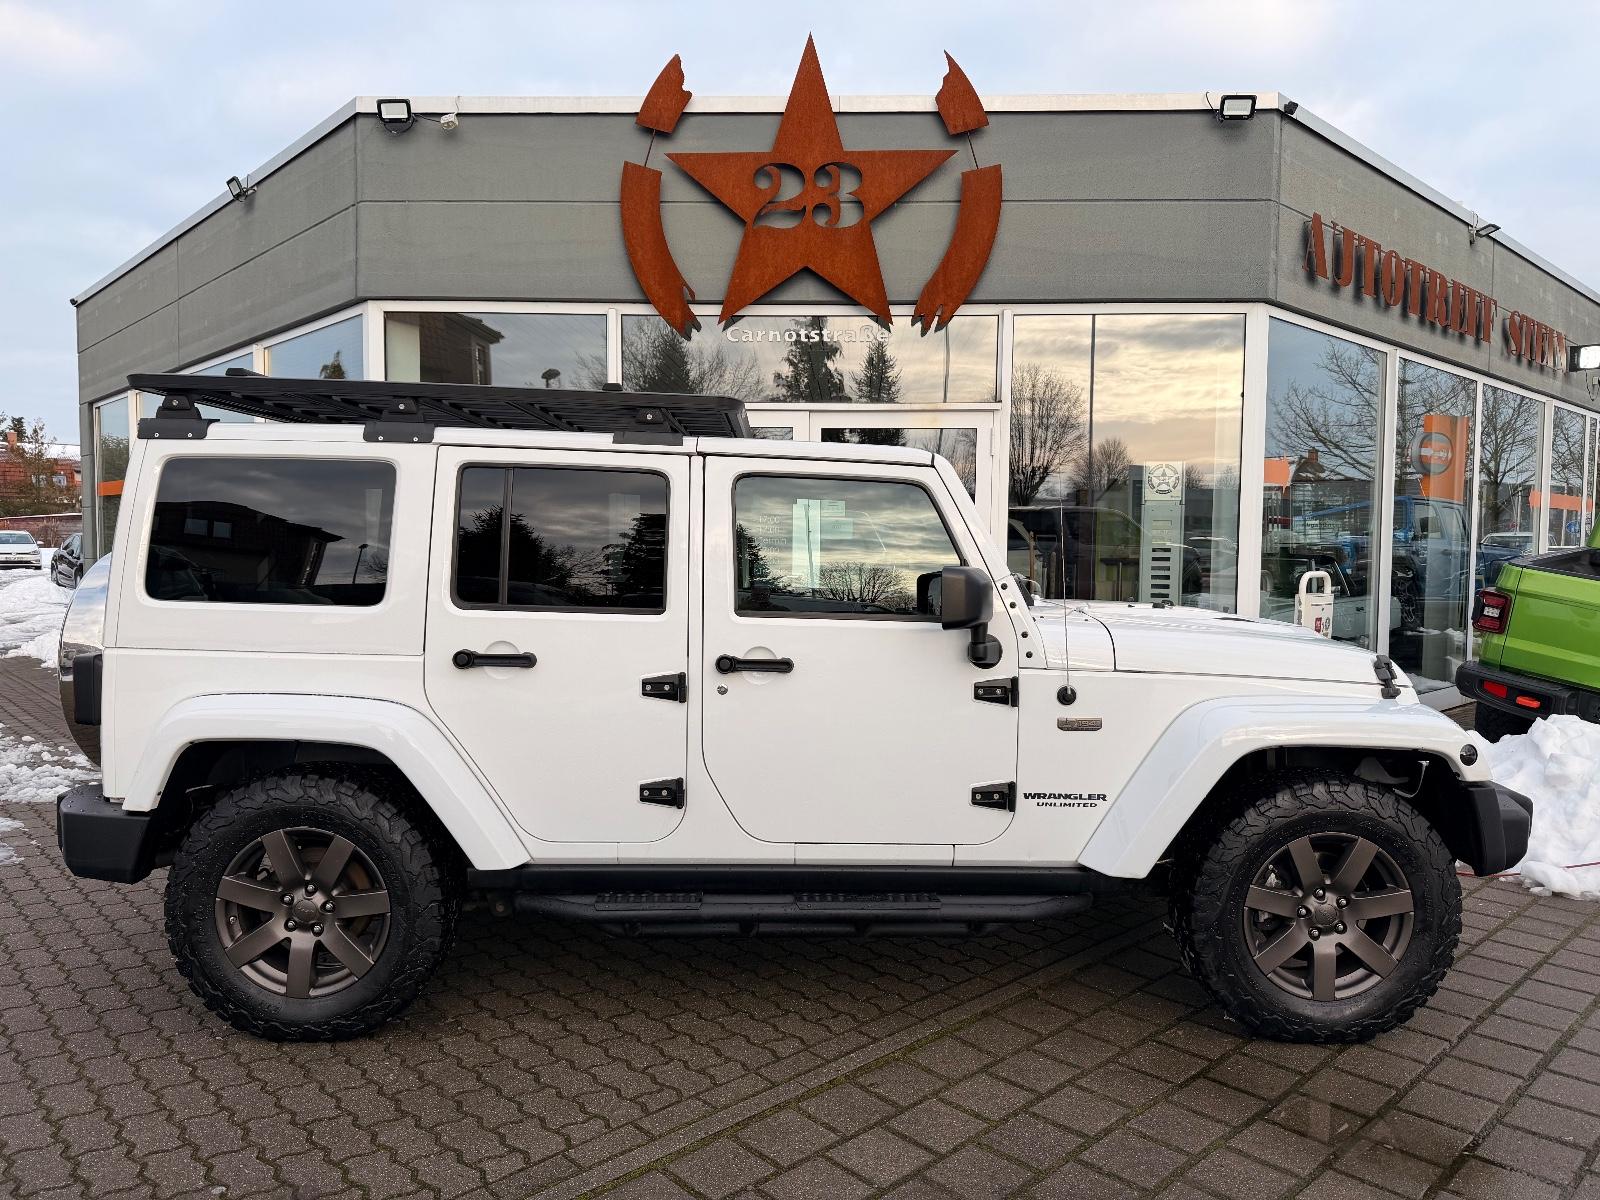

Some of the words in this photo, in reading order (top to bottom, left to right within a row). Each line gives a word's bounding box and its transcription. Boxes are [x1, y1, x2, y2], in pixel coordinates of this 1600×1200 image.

[752, 161, 865, 230] 23
[726, 324, 890, 343] Carnotstraße
[1023, 792, 1107, 801] WRANGLER
